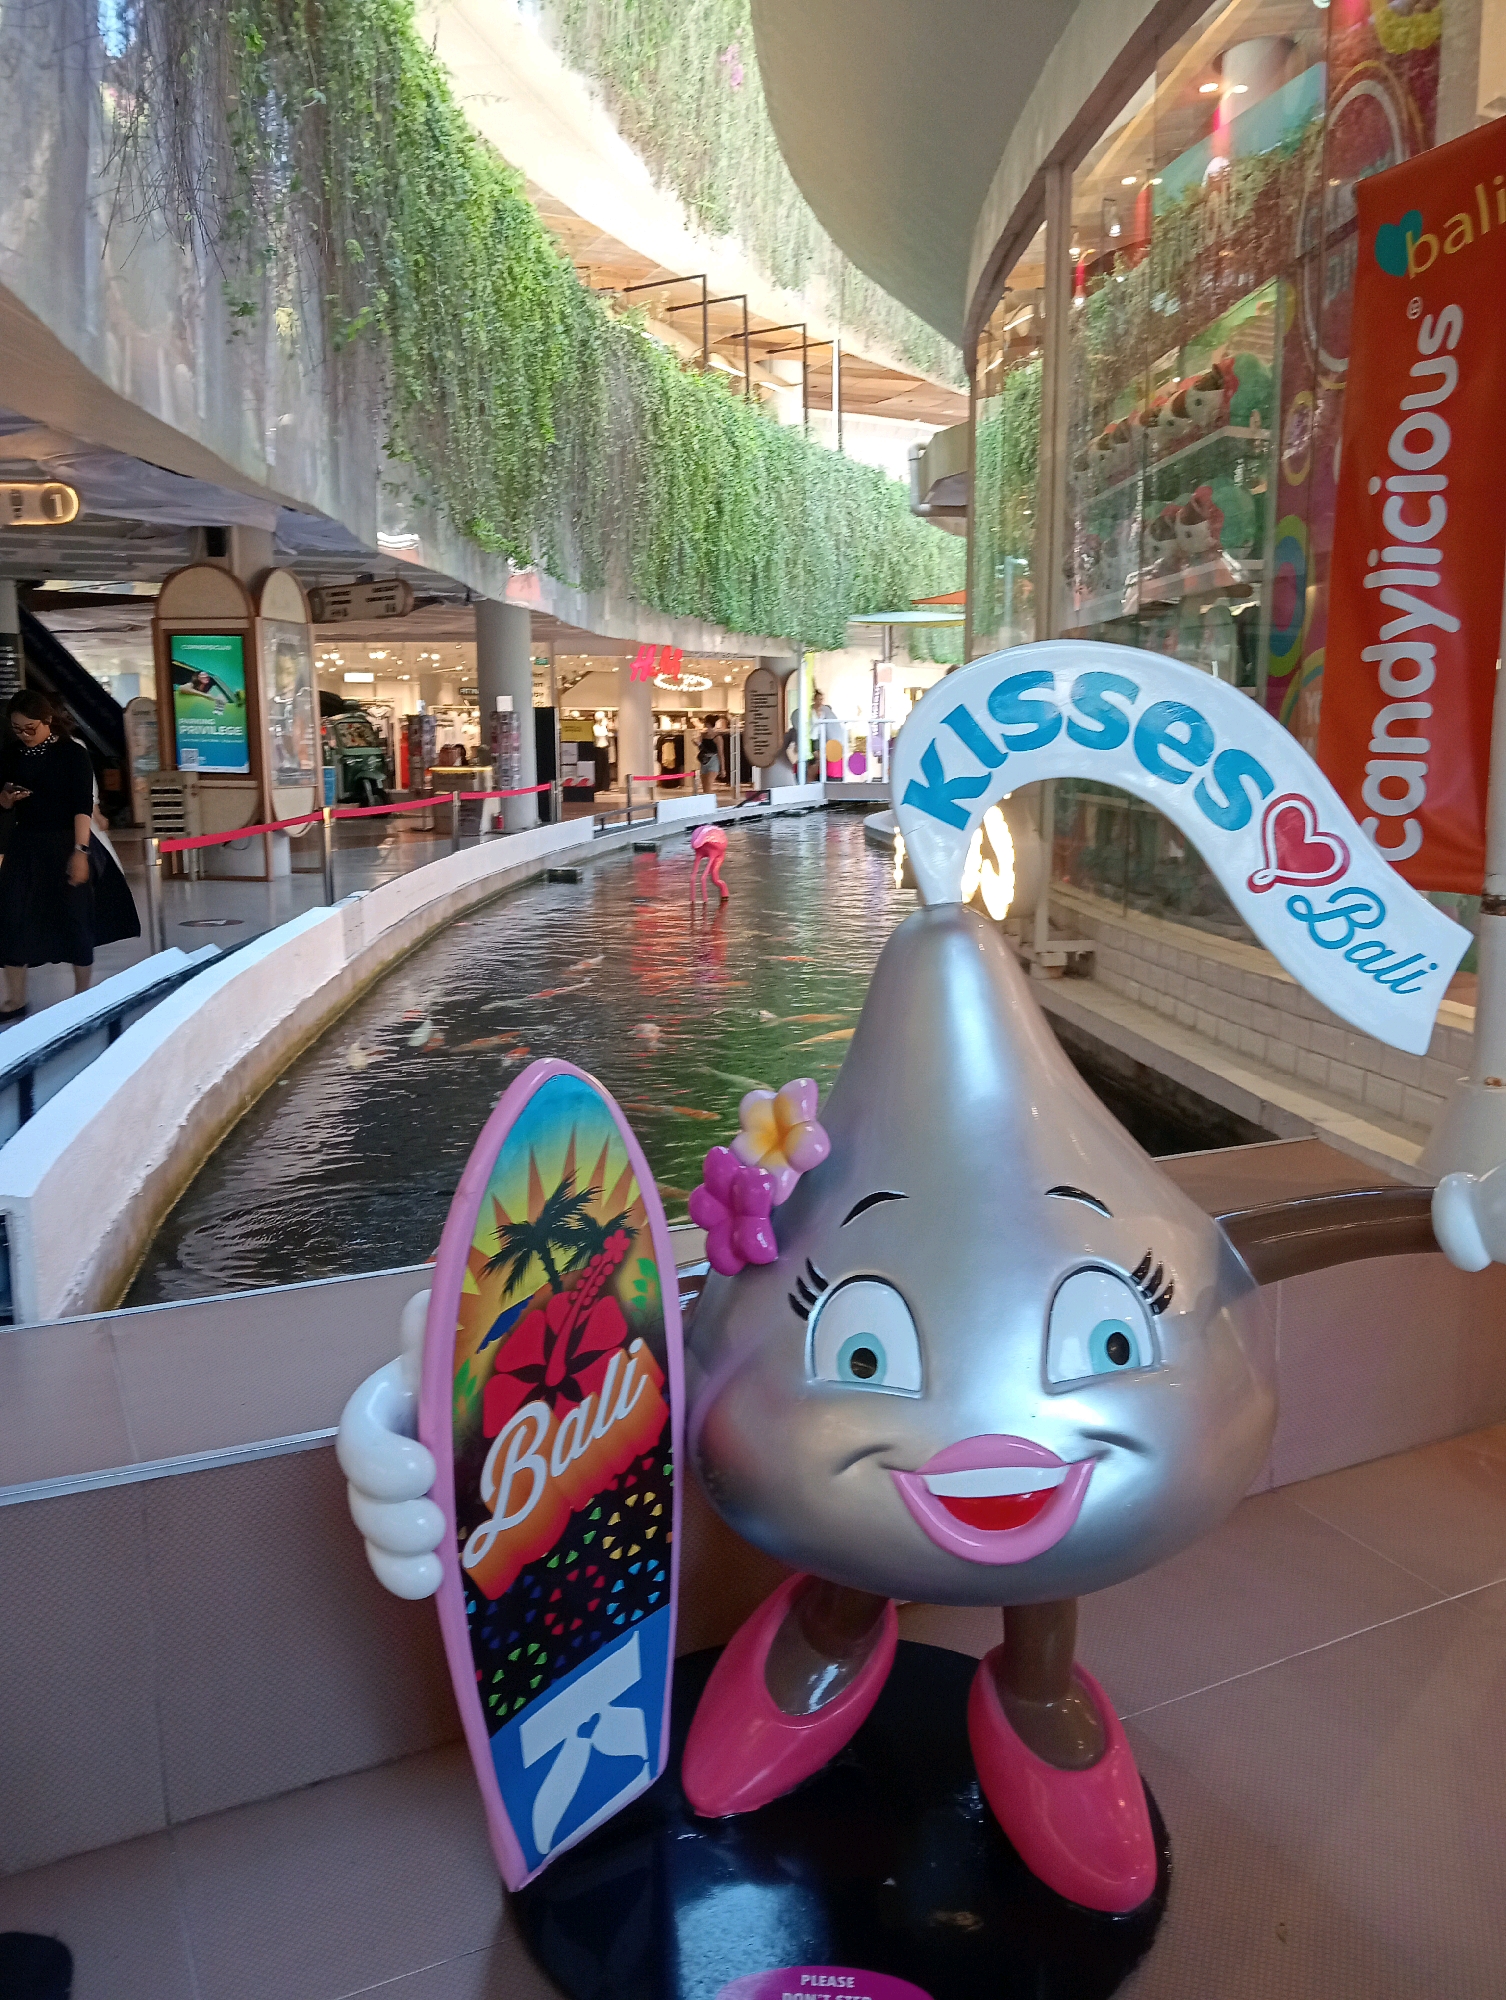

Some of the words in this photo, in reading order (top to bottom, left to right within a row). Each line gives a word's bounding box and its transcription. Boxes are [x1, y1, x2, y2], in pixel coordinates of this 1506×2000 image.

[1405, 175, 1506, 280] bali
[179, 725, 243, 735] PRIVILEGE
[1286, 886, 1438, 994] Bali
[463, 1337, 648, 1568] Bali
[800, 1974, 855, 1988] PLEASE
